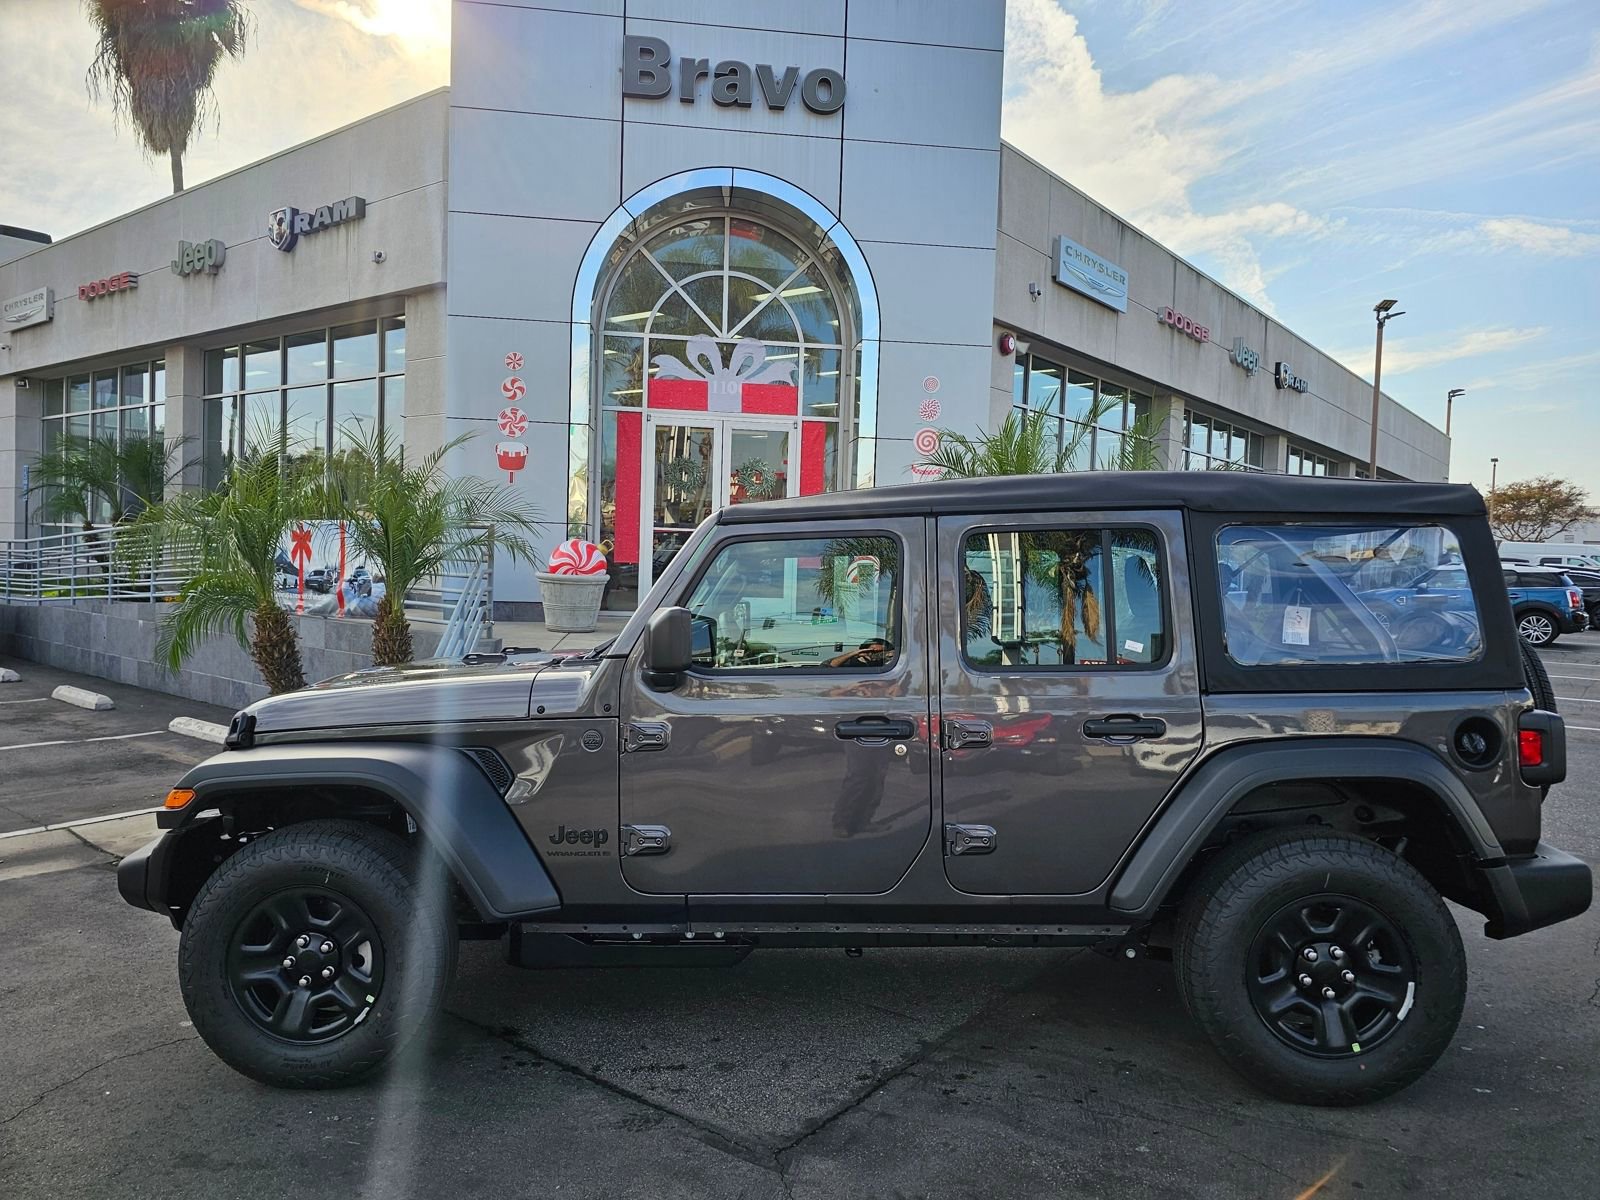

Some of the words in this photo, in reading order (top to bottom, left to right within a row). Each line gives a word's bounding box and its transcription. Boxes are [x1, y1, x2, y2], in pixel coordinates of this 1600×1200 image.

[623, 34, 847, 115] Bravo
[294, 196, 365, 236] RAM
[171, 238, 225, 277] Jeep
[1065, 245, 1127, 286] CHRYSLER
[4, 293, 44, 312] CHRYSLER
[78, 271, 138, 301] DODGE
[1160, 306, 1210, 343] DODGE
[1231, 337, 1259, 377] Jeep
[711, 381, 742, 394] 110
[1287, 373, 1309, 393] RAM
[549, 825, 609, 848] Jeep
